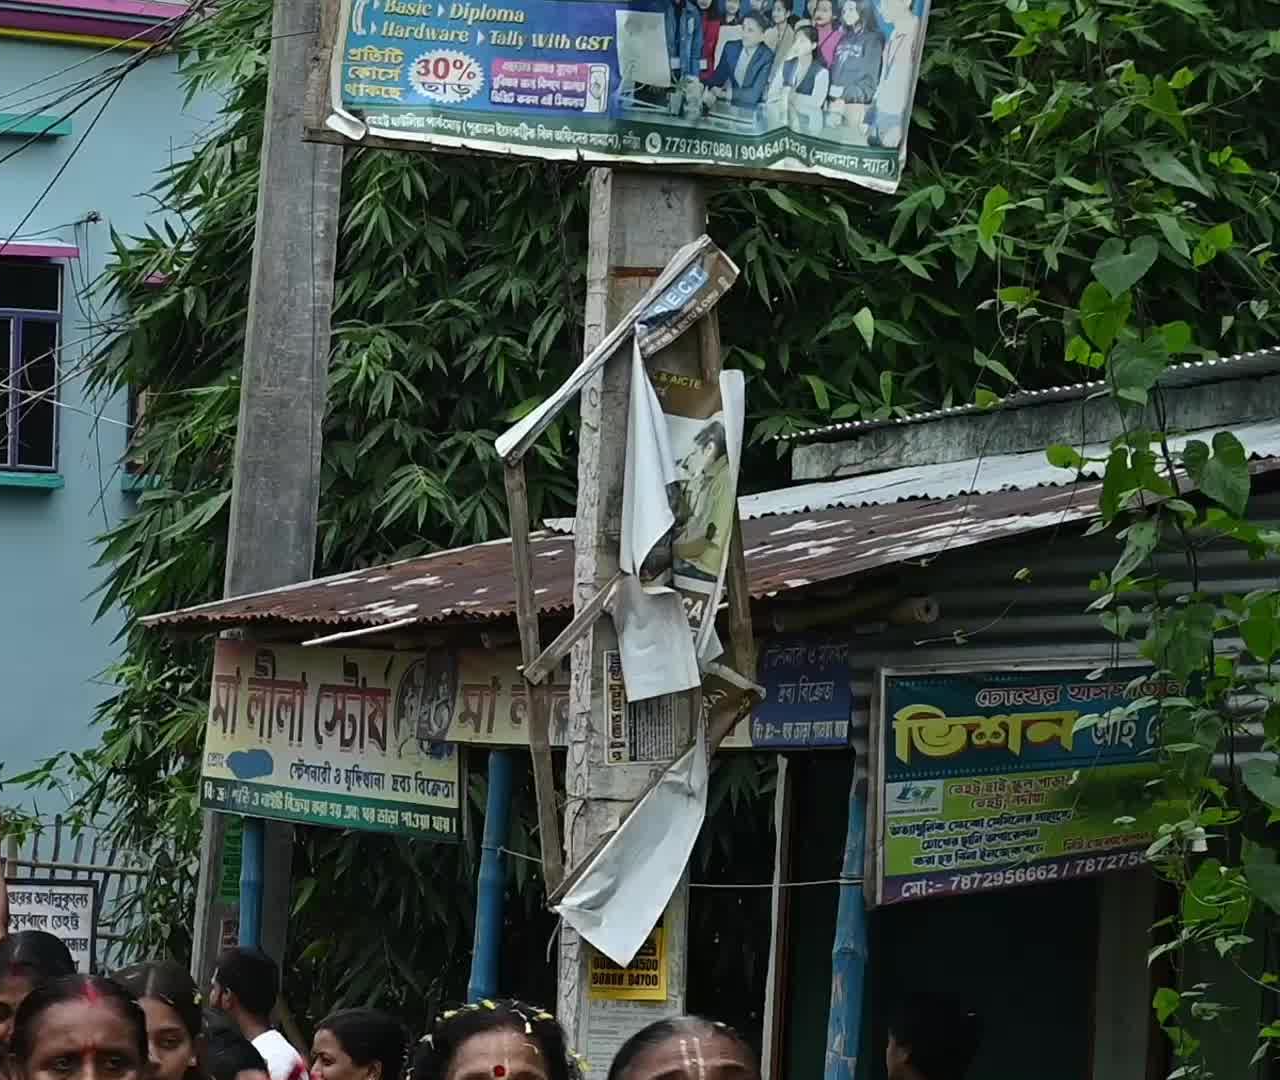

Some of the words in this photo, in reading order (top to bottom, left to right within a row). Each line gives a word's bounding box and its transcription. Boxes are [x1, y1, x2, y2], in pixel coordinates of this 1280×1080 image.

[384, 0, 432, 18] Basic
[450, 3, 525, 25] Diploma
[381, 21, 470, 43] Hardware
[490, 29, 524, 51] Tally
[576, 34, 614, 53] GST
[347, 45, 406, 64] প্রতিটি
[416, 57, 477, 81] 30%
[213, 666, 241, 735] মা
[246, 649, 308, 744] লীলা
[975, 685, 1063, 708] চোখের
[891, 703, 1080, 766] ভিশন
[414, 770, 456, 799] বিক্রেতা
[951, 865, 1059, 891] 7872956662
[51, 914, 81, 930] তেহট্ট
